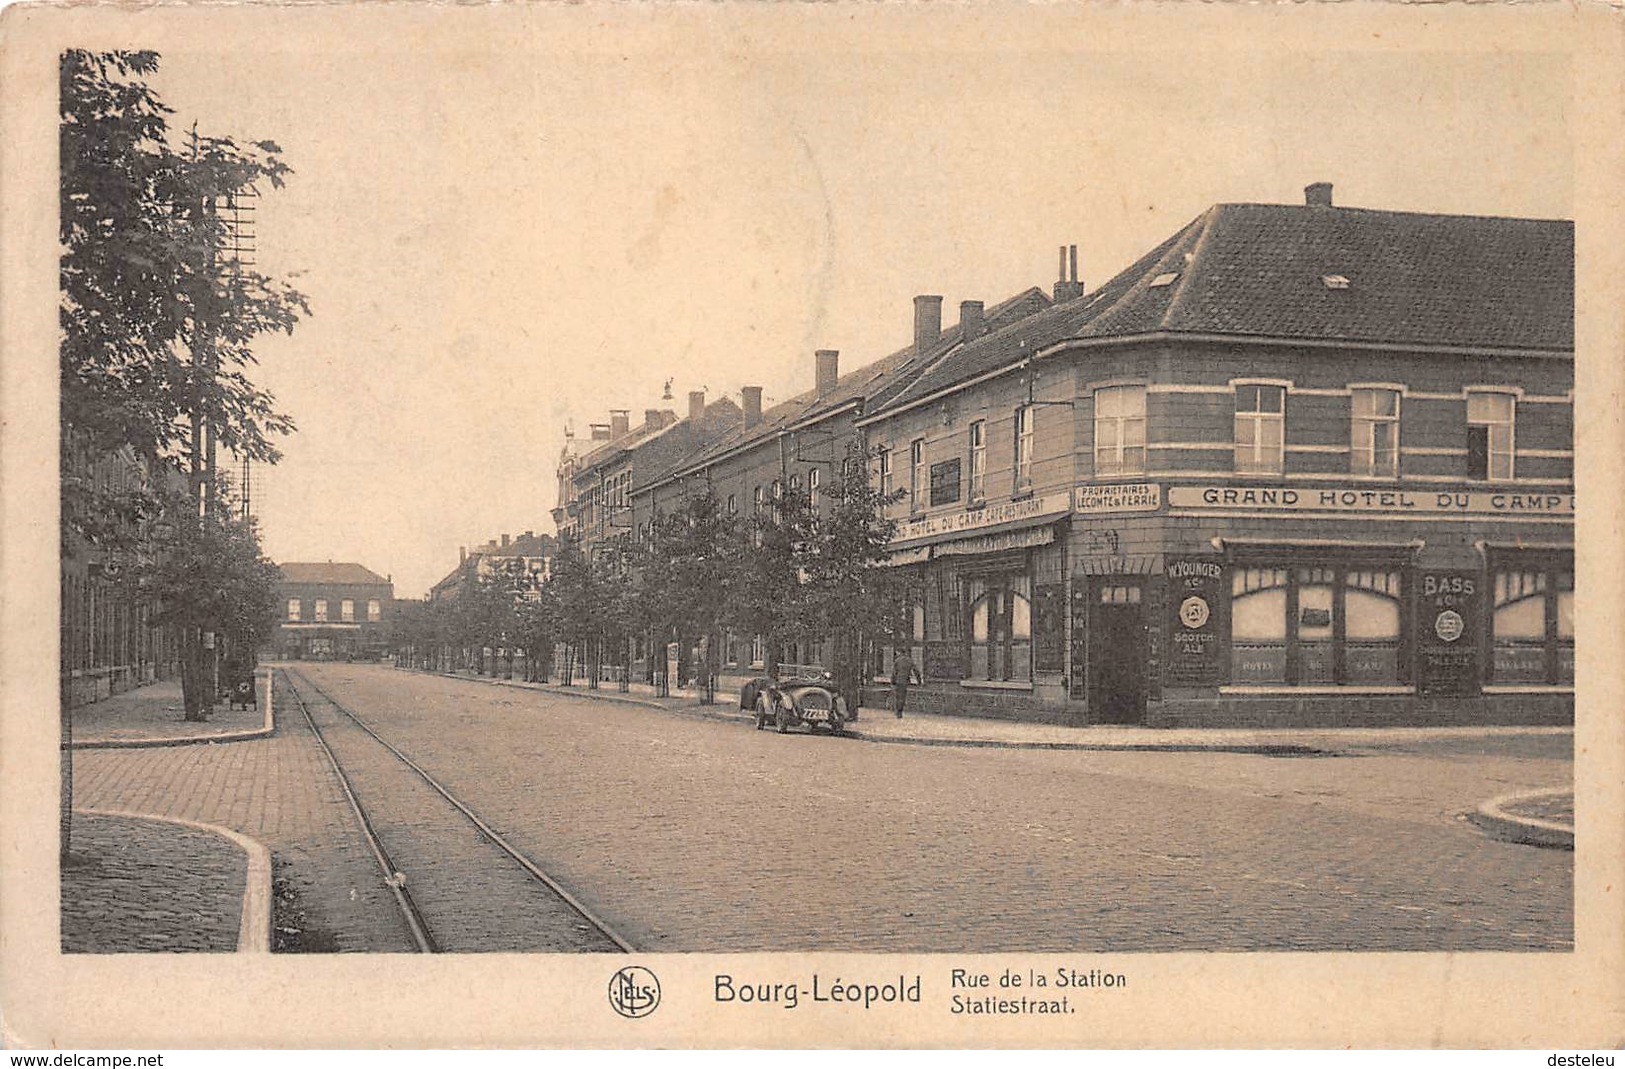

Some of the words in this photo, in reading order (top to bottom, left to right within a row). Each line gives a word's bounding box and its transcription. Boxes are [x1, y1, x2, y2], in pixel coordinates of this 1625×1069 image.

[1203, 488, 1299, 505] GRAND
[1319, 491, 1415, 507] HOTEL
[1436, 493, 1470, 508] DU
[1490, 494, 1562, 509] CAMP
[911, 521, 935, 537] HOTEL
[942, 518, 953, 530] DU
[959, 511, 983, 527] CAMP
[1424, 575, 1475, 596] BASS
[1183, 643, 1205, 653] ALE
[951, 969, 990, 988] Rue
[999, 969, 1022, 988] de
[1030, 969, 1048, 988] la
[1056, 968, 1127, 988] Station
[714, 974, 921, 1009] Bourg-Léopold
[950, 995, 1076, 1015] Statiestraat.
